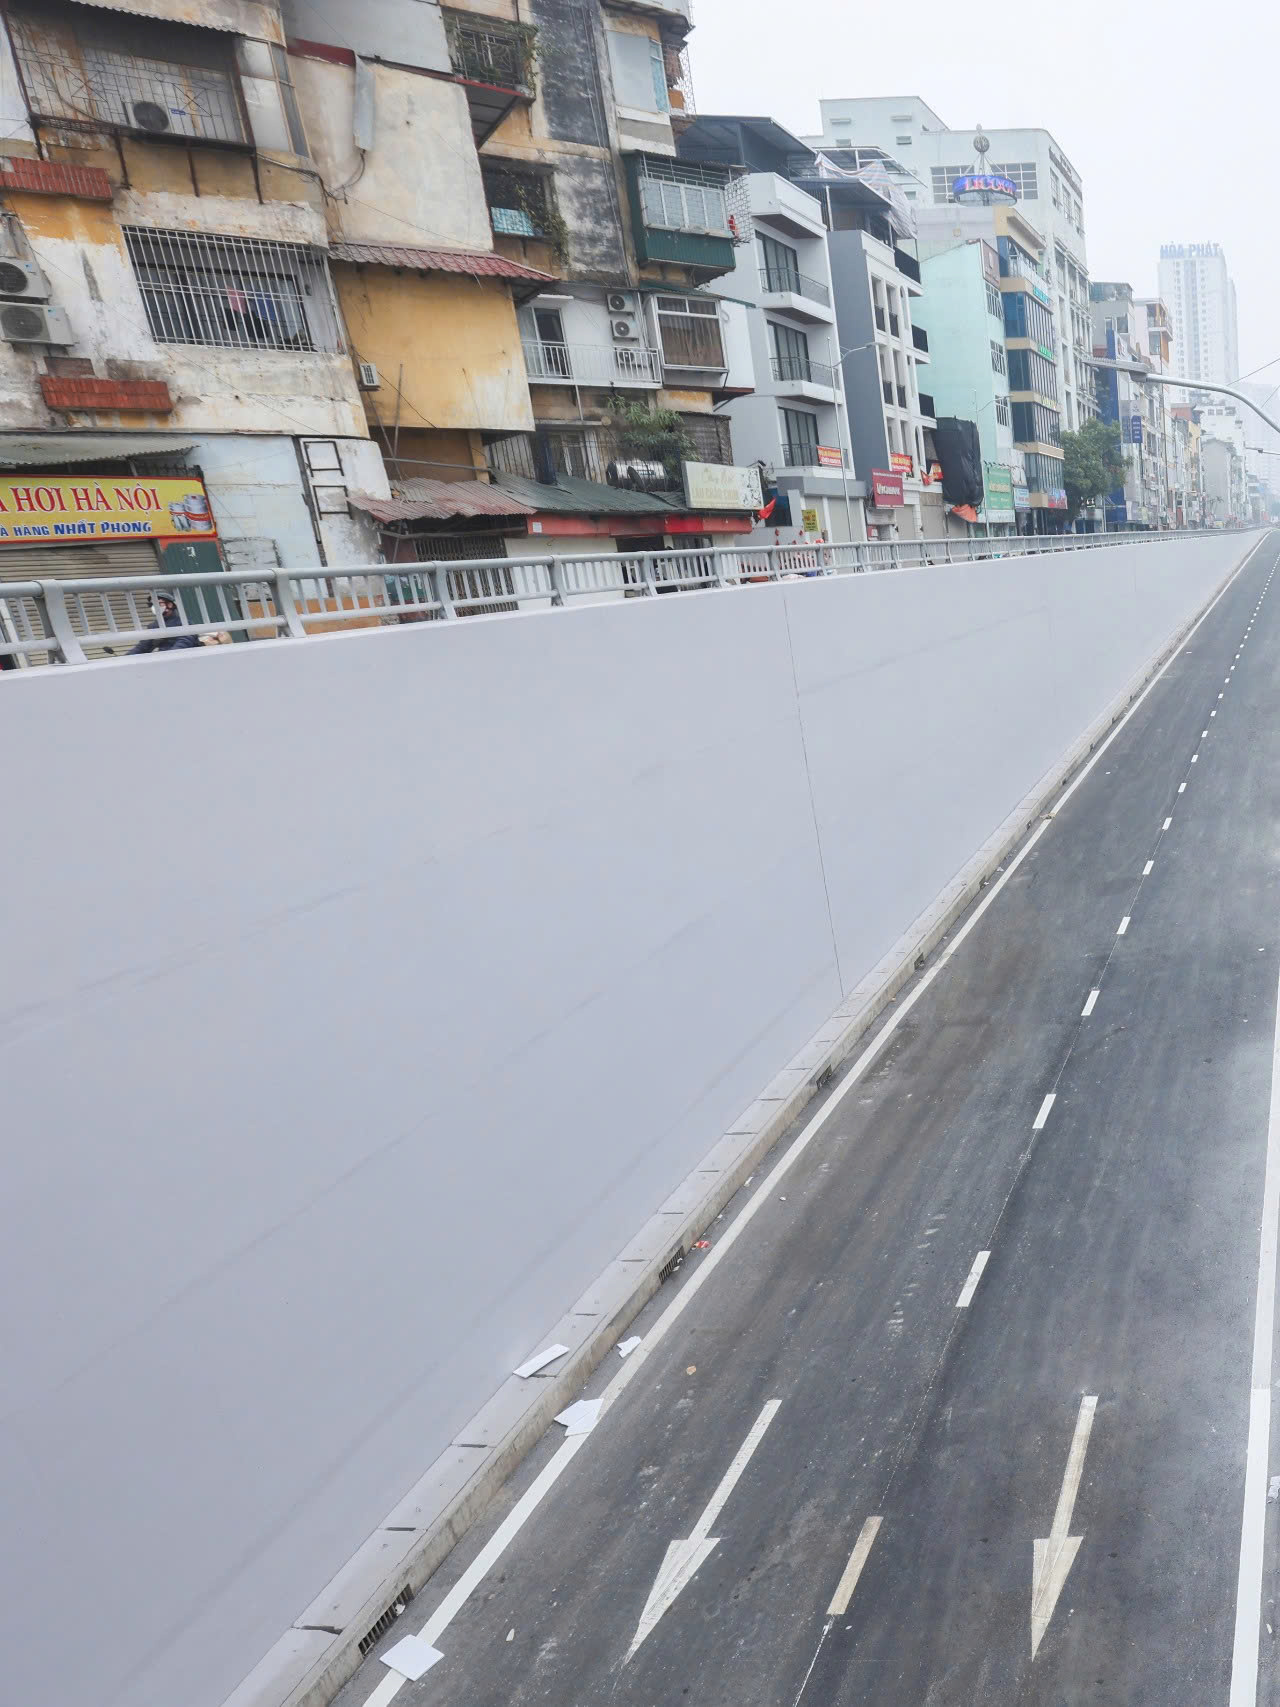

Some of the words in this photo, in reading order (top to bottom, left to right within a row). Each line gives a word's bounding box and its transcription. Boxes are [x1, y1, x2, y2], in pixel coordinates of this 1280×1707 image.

[9, 486, 67, 512] HƠI
[70, 481, 113, 511] HÀ
[113, 482, 162, 516] NỘI
[13, 524, 50, 537] HÀNG
[53, 519, 96, 535] NHẤT
[100, 521, 152, 534] PHONG
